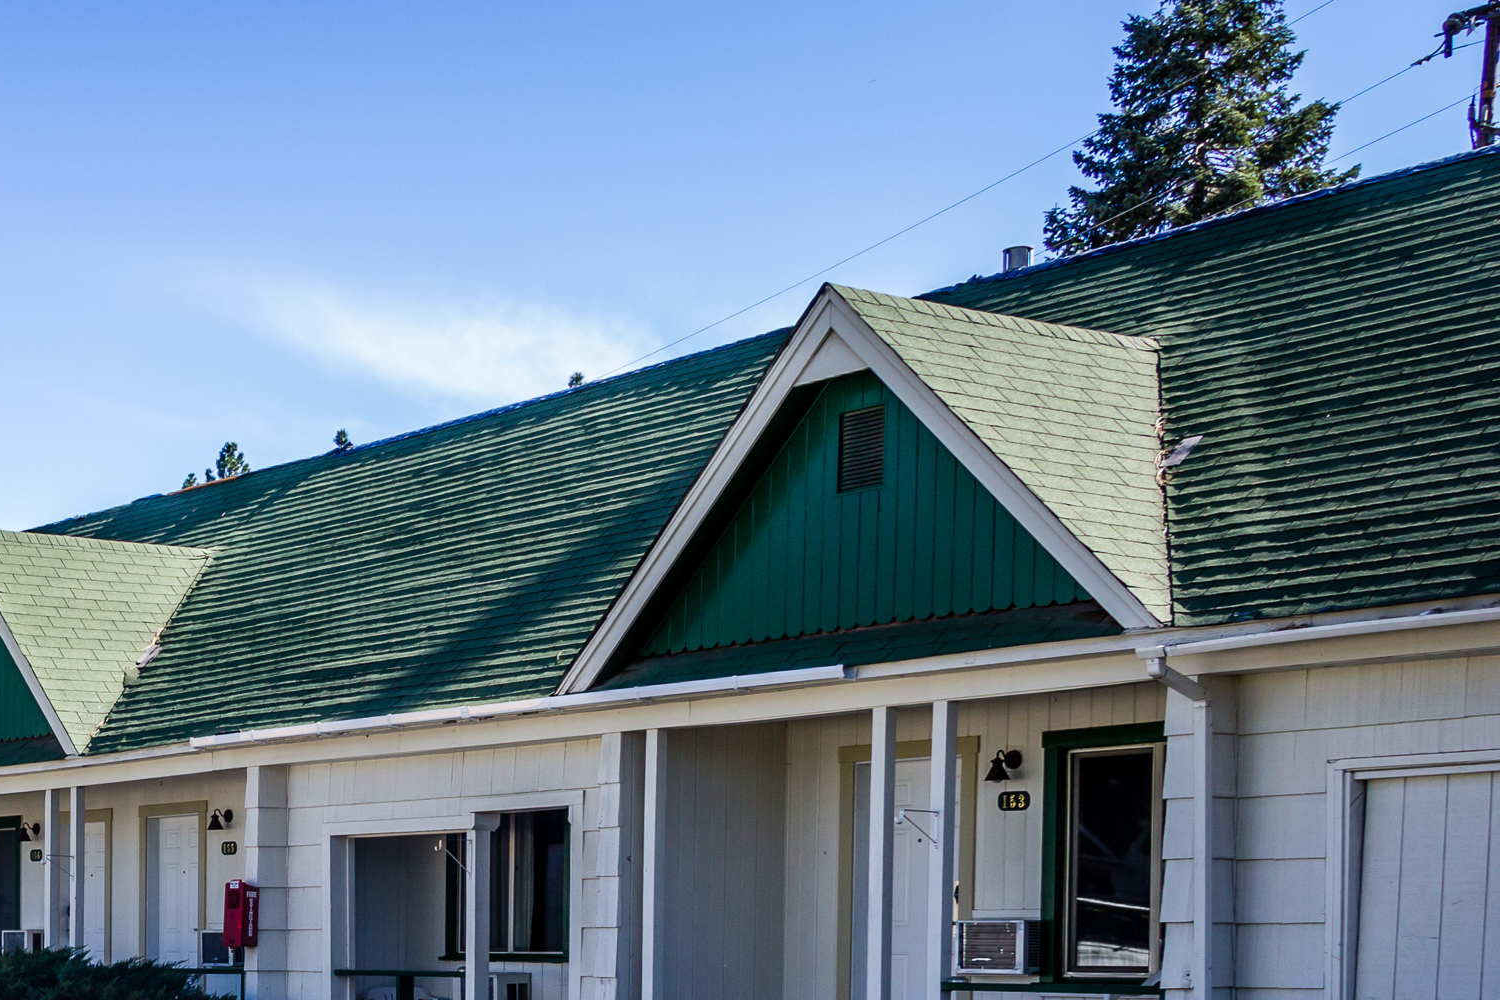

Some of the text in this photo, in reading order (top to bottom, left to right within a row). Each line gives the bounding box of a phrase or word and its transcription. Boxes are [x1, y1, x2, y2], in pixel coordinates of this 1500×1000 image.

[1002, 794, 1025, 809] 153
[223, 843, 235, 854] 155
[246, 890, 257, 898] FIRE
